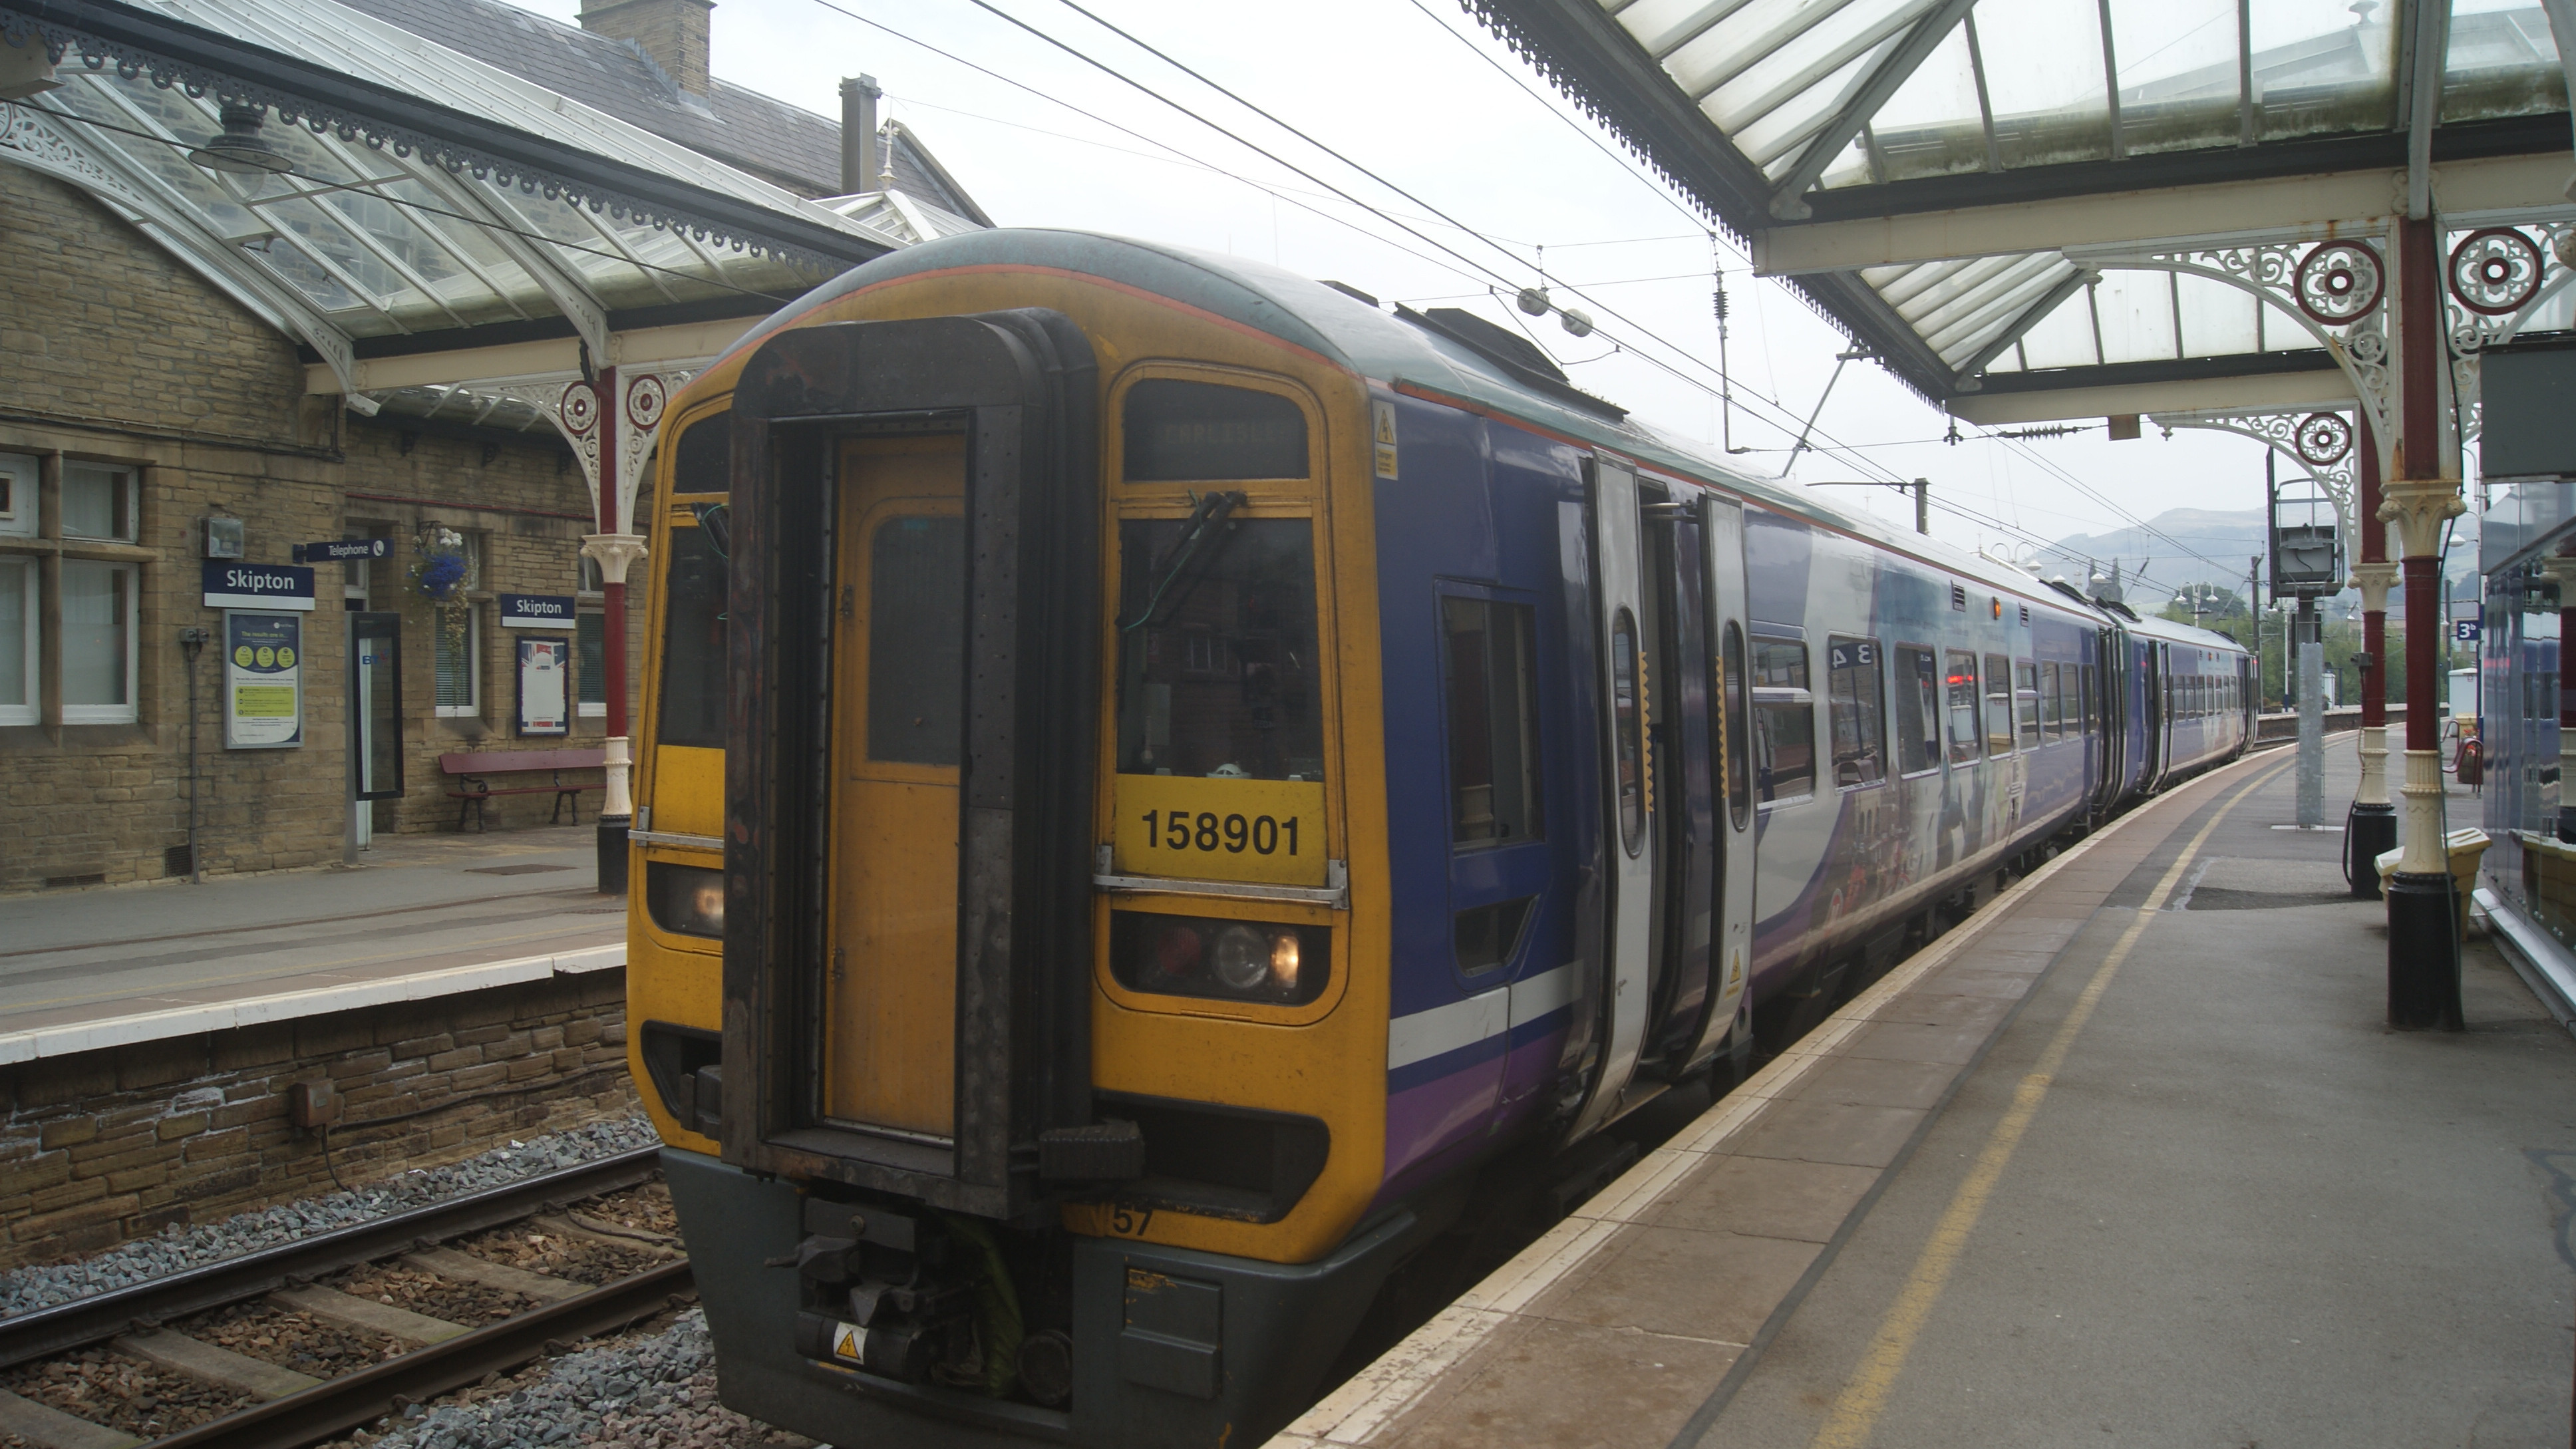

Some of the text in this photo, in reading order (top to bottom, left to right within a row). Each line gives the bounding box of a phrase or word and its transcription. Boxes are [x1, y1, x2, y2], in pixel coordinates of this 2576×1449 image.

[1165, 422, 1275, 444] CARLISLE
[329, 545, 369, 558] Telephone
[227, 570, 295, 592] Skipton
[516, 599, 562, 616] Skipton
[362, 655, 379, 665] BT
[1142, 810, 1299, 856] 158901
[1112, 1204, 1153, 1236] 57
